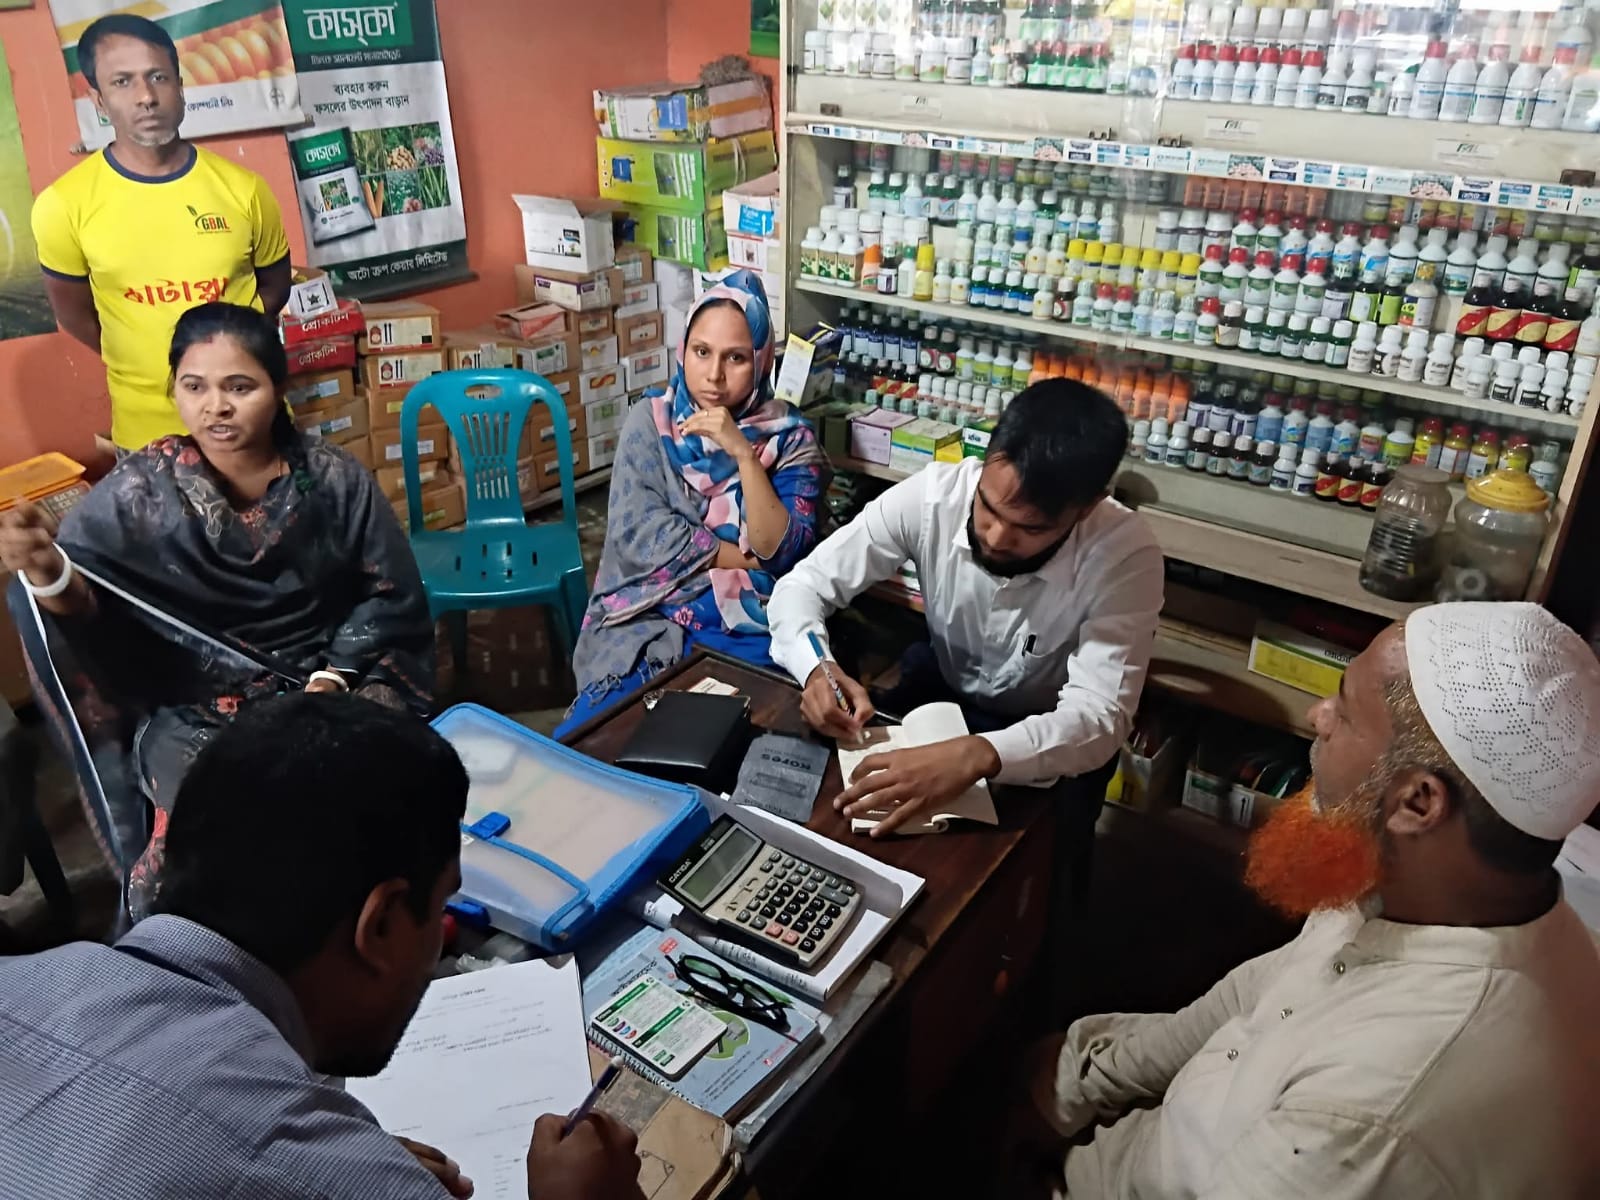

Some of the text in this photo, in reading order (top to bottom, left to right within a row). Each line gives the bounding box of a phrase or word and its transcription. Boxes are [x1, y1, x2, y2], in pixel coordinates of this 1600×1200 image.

[333, 80, 389, 95] ব্যবহার করুন
[313, 101, 346, 115] ফসলের
[348, 97, 383, 110] উৎপাদন
[201, 215, 230, 231] GBAL
[347, 266, 371, 280] অটো
[390, 259, 414, 273] কেয়ার
[415, 251, 448, 268] লিমিটেড
